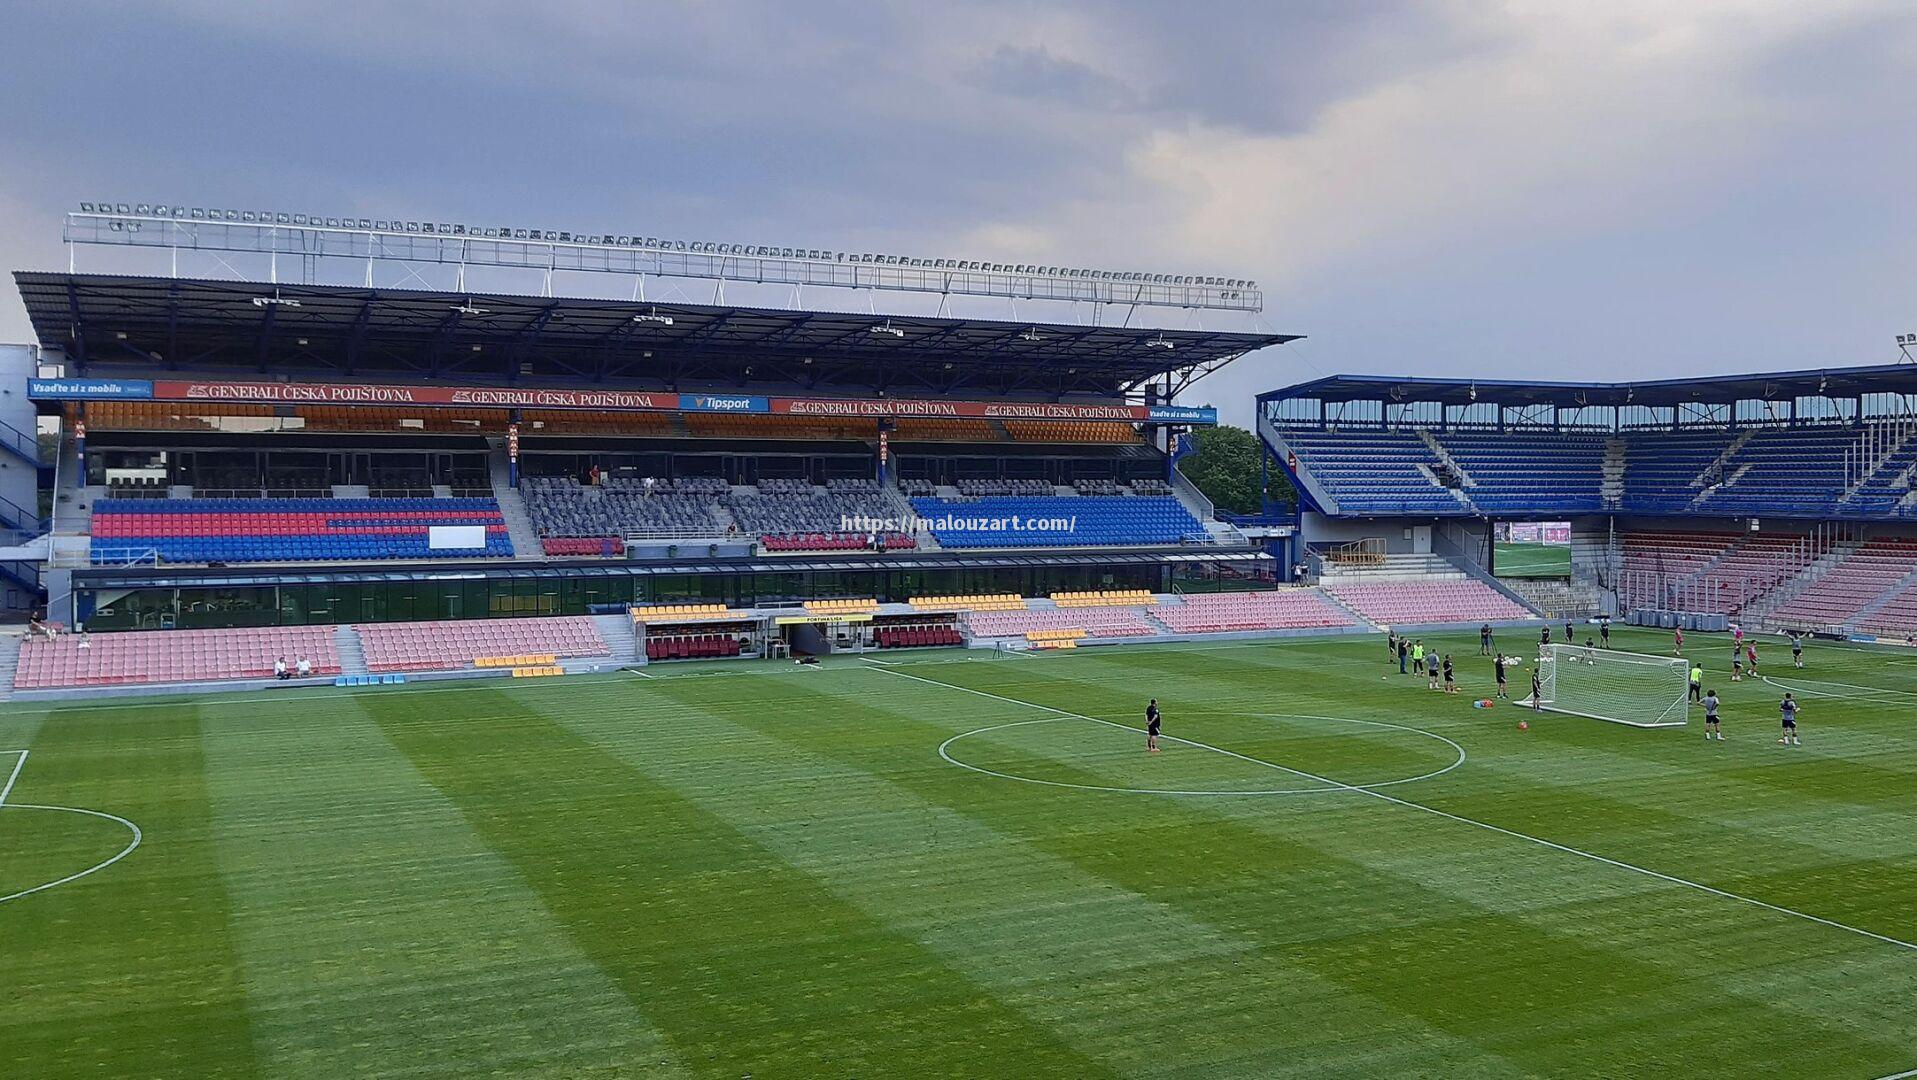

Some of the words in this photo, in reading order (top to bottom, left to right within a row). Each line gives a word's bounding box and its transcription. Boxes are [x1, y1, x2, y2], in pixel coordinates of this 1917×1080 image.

[70, 384, 79, 393] si
[88, 384, 122, 394] mobilu
[209, 386, 280, 399] GENERALI
[283, 384, 327, 400] ČESKÁ
[332, 386, 414, 402] POJIŠŤOVNA
[471, 392, 534, 404] GENERALI
[537, 390, 576, 406] ČESKÁ
[580, 392, 653, 407] POJIŠŤOVNA
[706, 397, 750, 410] Tipsport
[806, 402, 859, 414] GENERALI
[861, 401, 894, 414] ČESKÁ
[896, 402, 957, 416] POJIŠŤOVNA
[999, 406, 1045, 417] GENERALI
[1047, 405, 1077, 418] ČESKÁ
[1079, 406, 1132, 419] POJIŠŤOVNA
